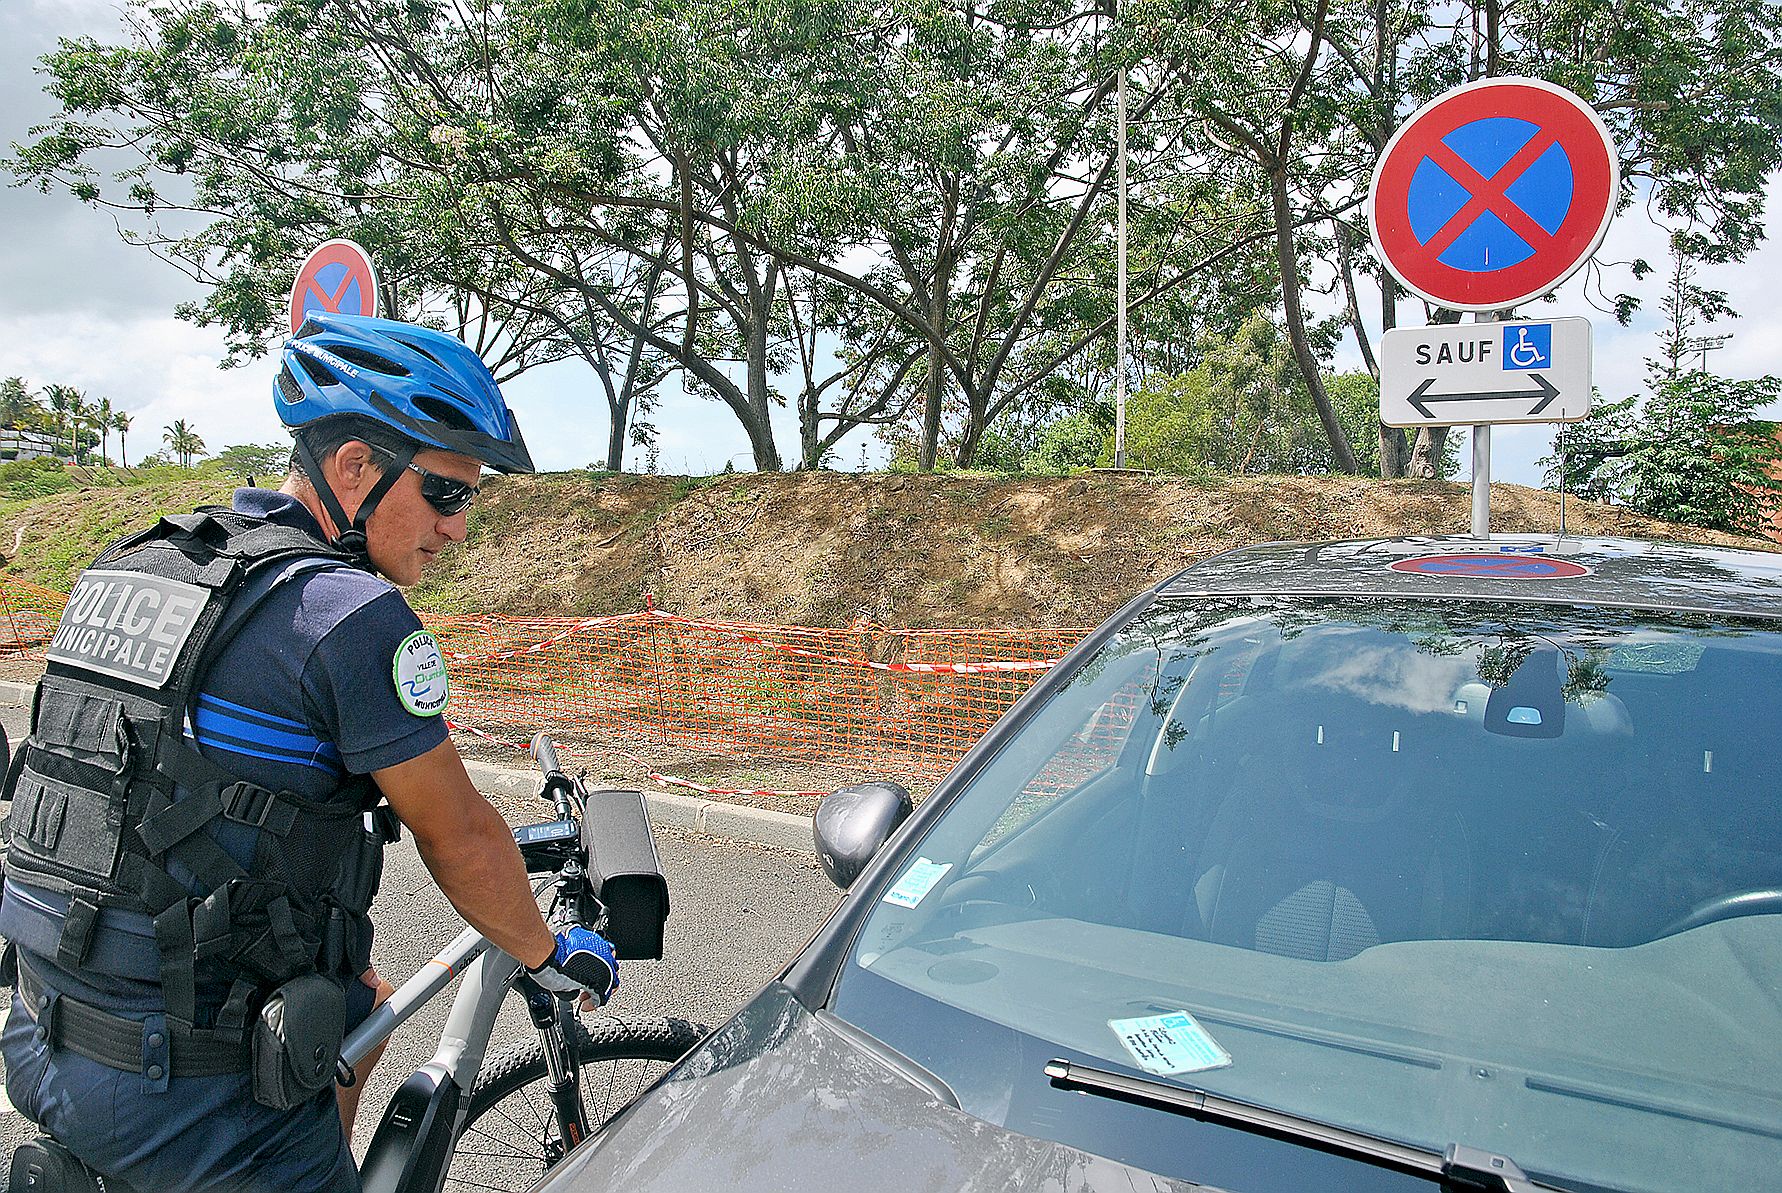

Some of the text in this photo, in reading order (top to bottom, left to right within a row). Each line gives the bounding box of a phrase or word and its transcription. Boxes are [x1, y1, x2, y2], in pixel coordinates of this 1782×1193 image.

[313, 346, 359, 378] MUNICIPALE
[1415, 341, 1493, 365] SAUF
[69, 581, 196, 645] POLICE
[53, 625, 171, 675] UNICIPALE
